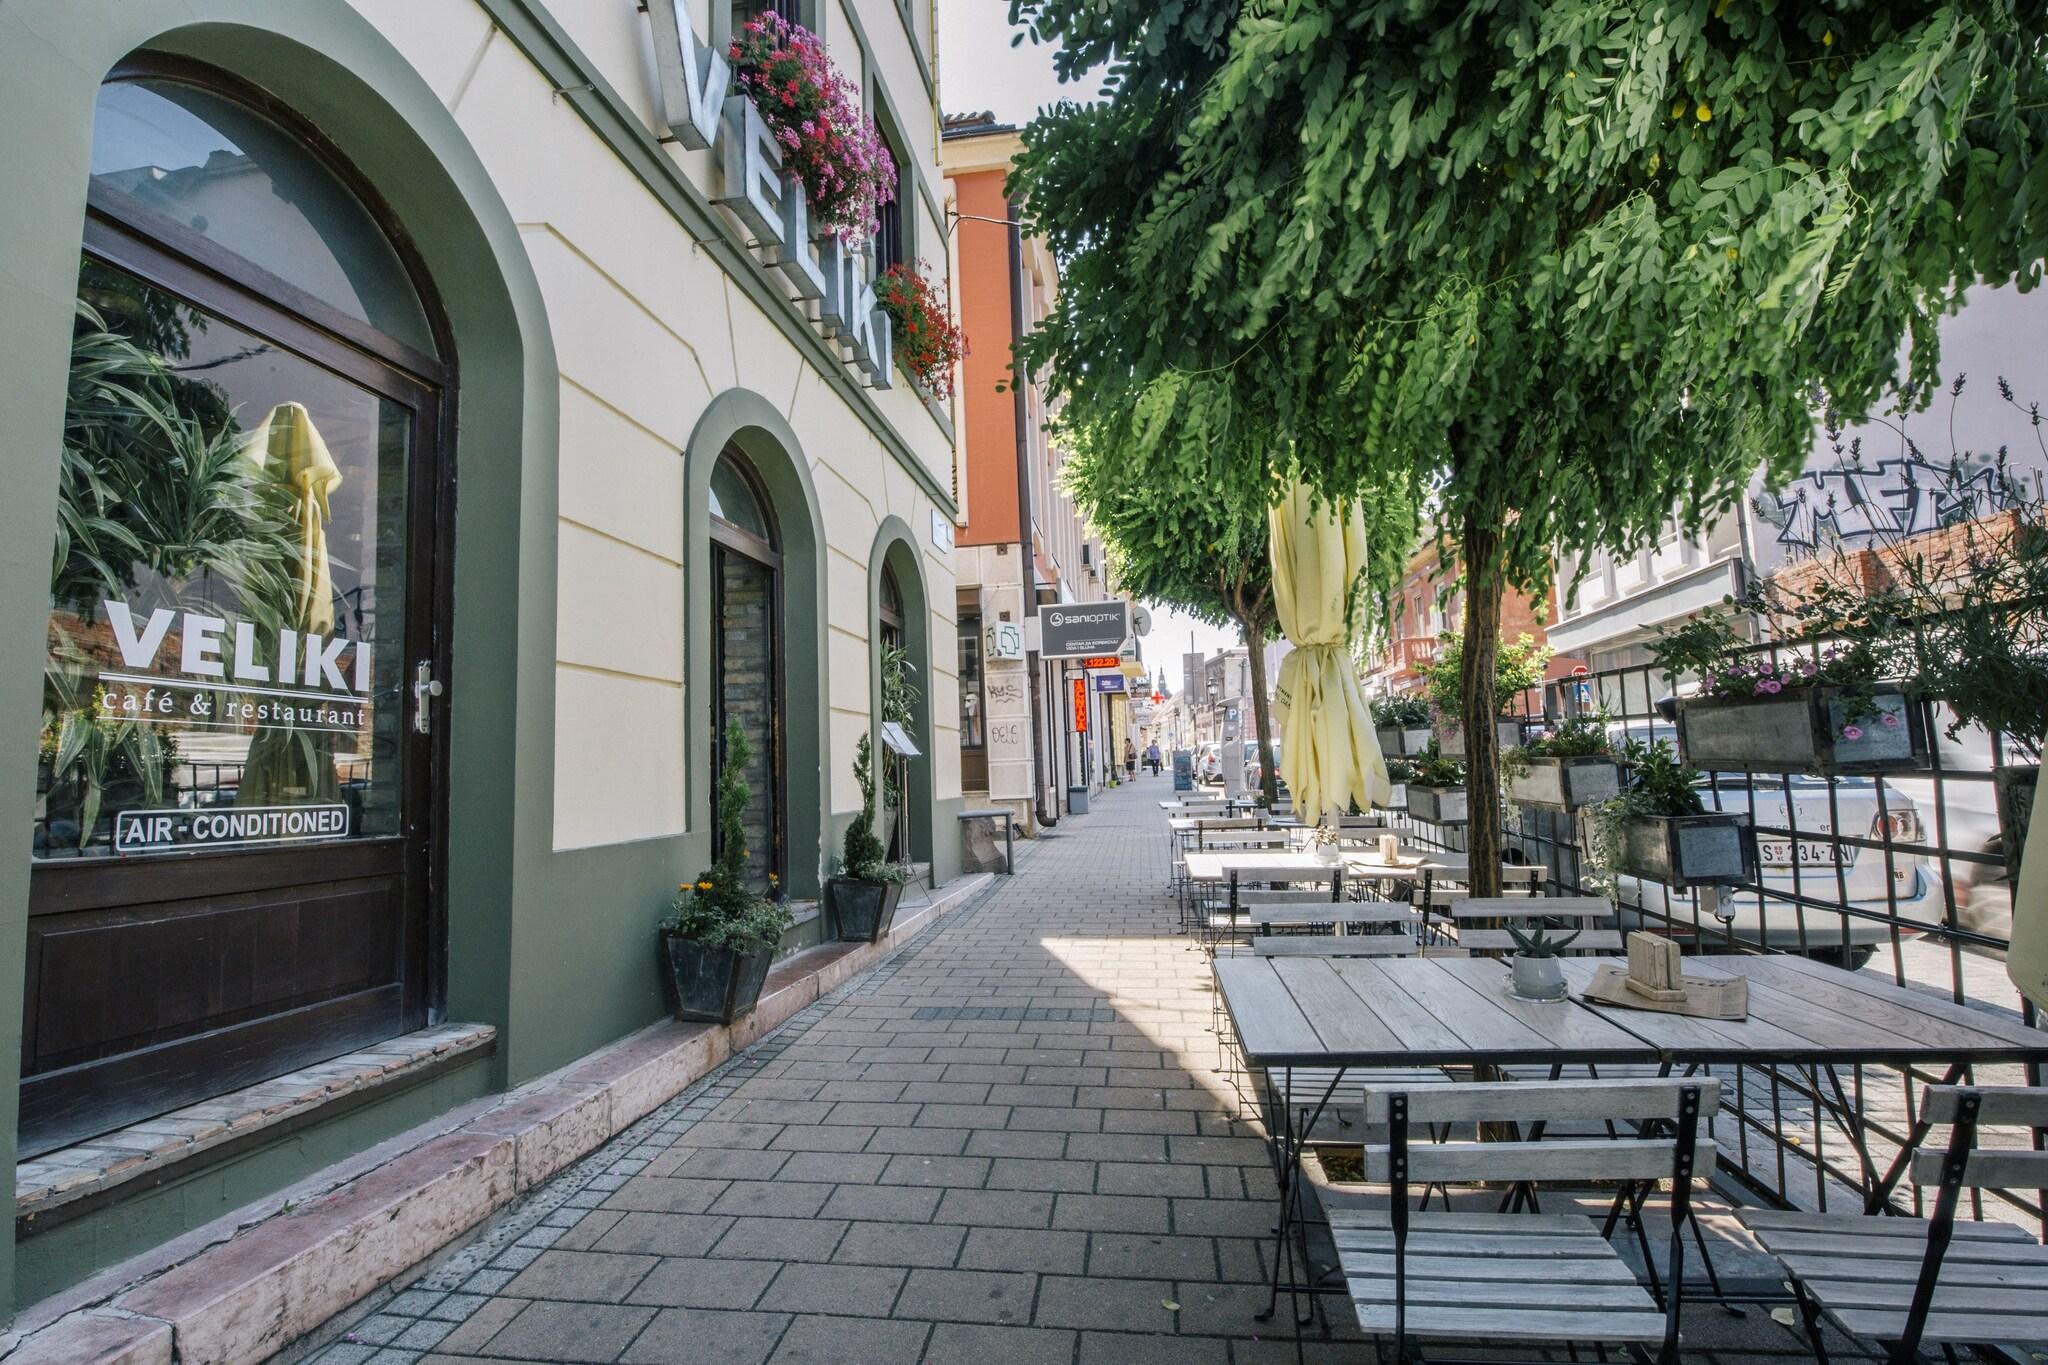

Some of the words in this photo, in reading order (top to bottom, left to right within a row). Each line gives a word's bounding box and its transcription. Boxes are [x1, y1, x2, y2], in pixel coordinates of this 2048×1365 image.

[645, 0, 893, 390] VELIKI
[104, 599, 371, 692] VELIKI
[102, 688, 174, 714] café
[190, 693, 212, 715] &
[226, 700, 366, 727] restaurant
